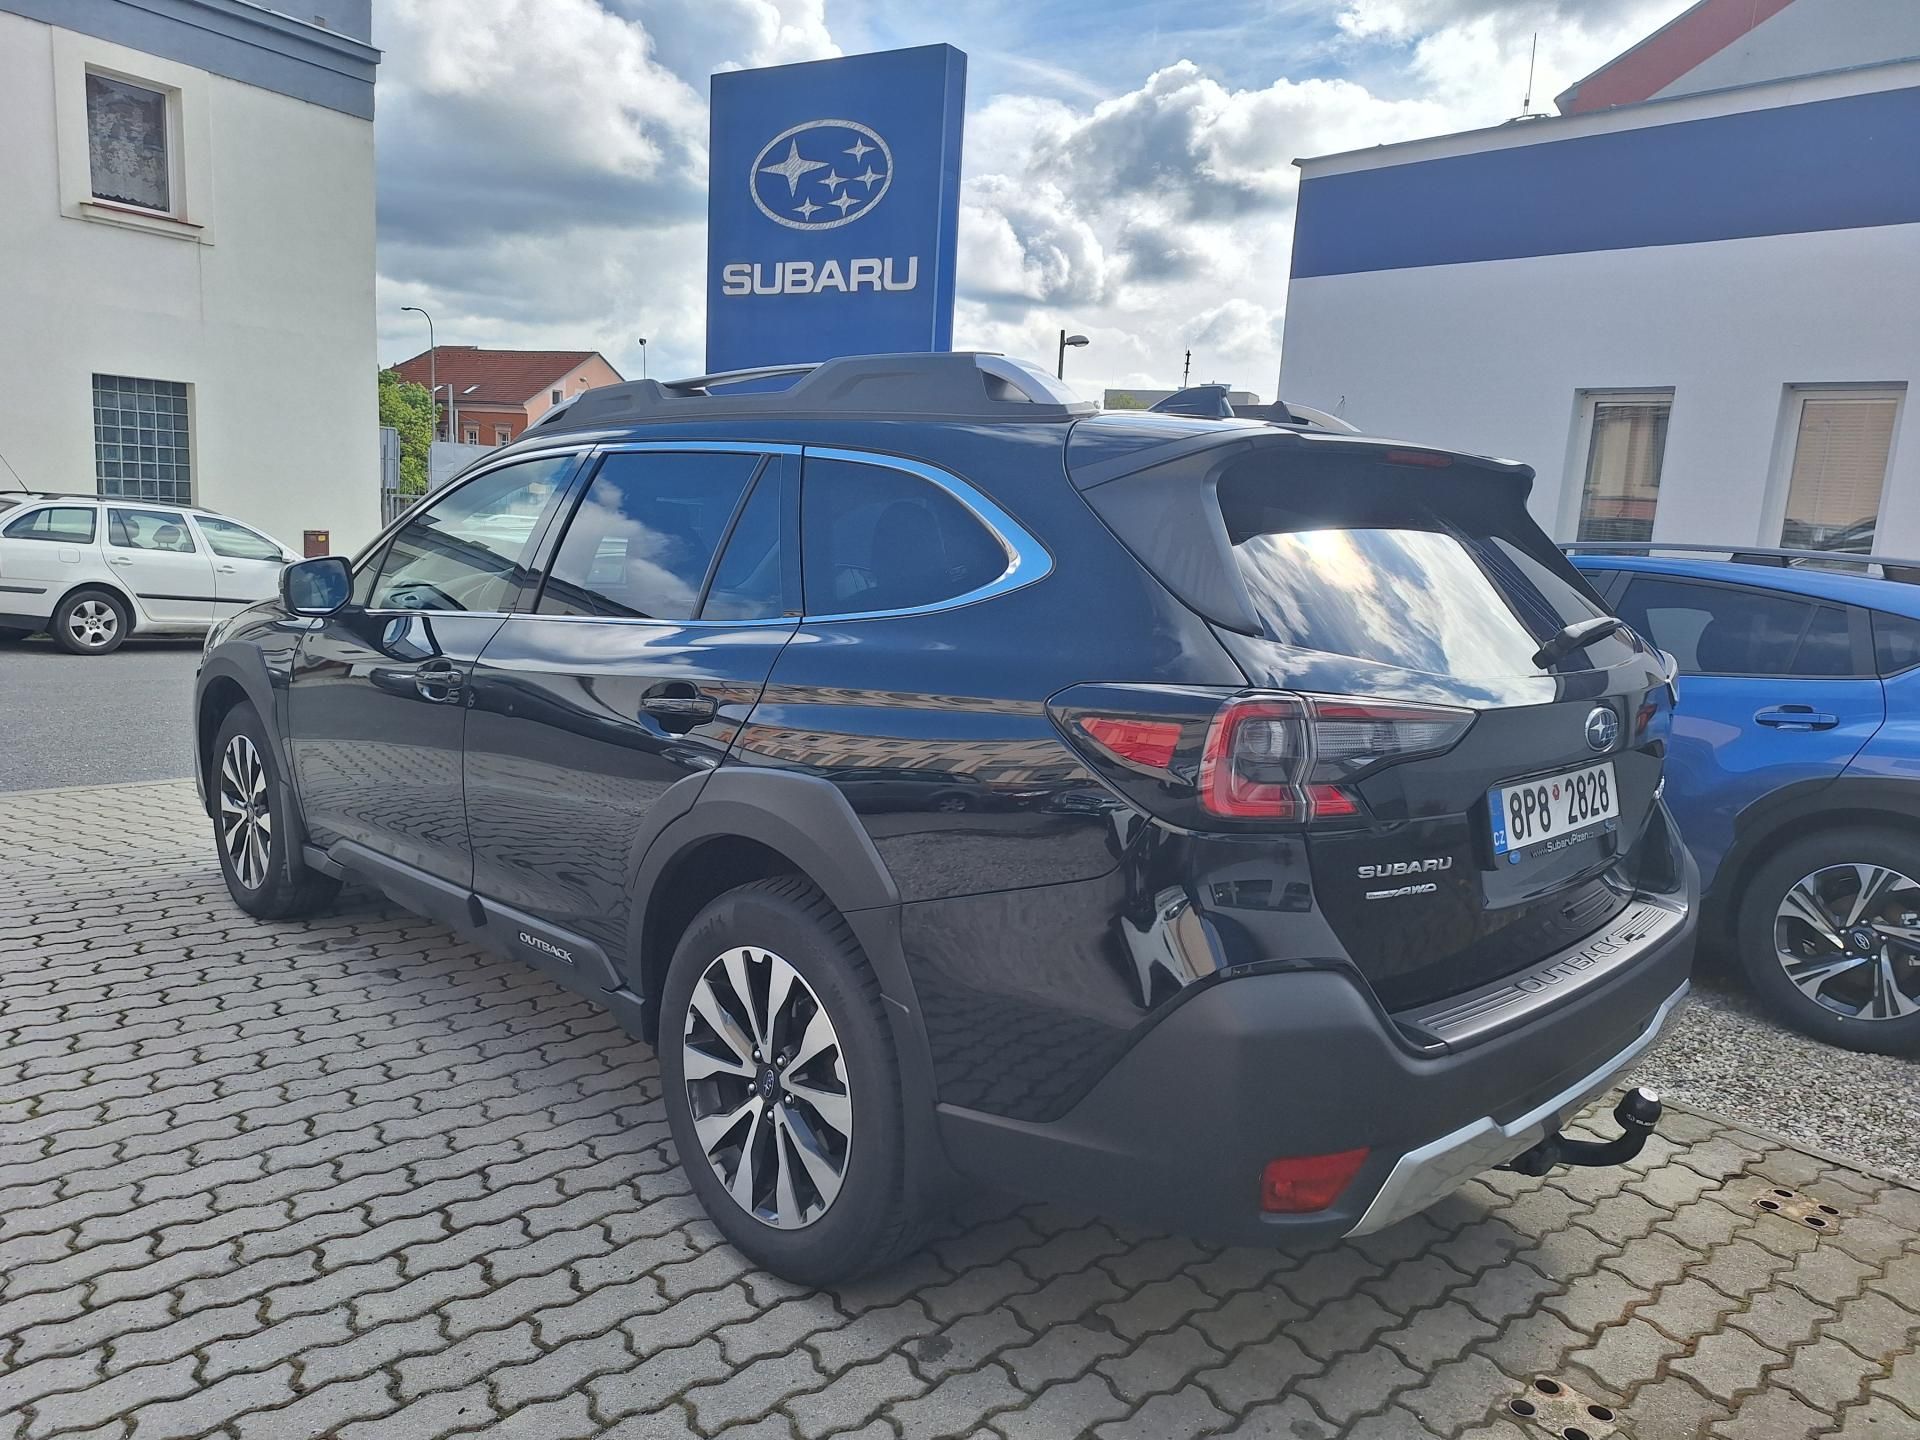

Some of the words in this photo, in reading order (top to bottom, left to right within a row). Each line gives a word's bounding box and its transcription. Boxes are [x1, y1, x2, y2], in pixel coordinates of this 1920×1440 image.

[722, 256, 918, 295] SUBARU
[1509, 785, 1552, 840] 8P8
[1564, 769, 1610, 825] 2828
[1493, 830, 1506, 846] CZ
[1357, 856, 1453, 879] SUBARU
[1394, 882, 1437, 897] AWD
[519, 932, 573, 963] OUTBACK
[1513, 936, 1630, 994] OUTBACK
